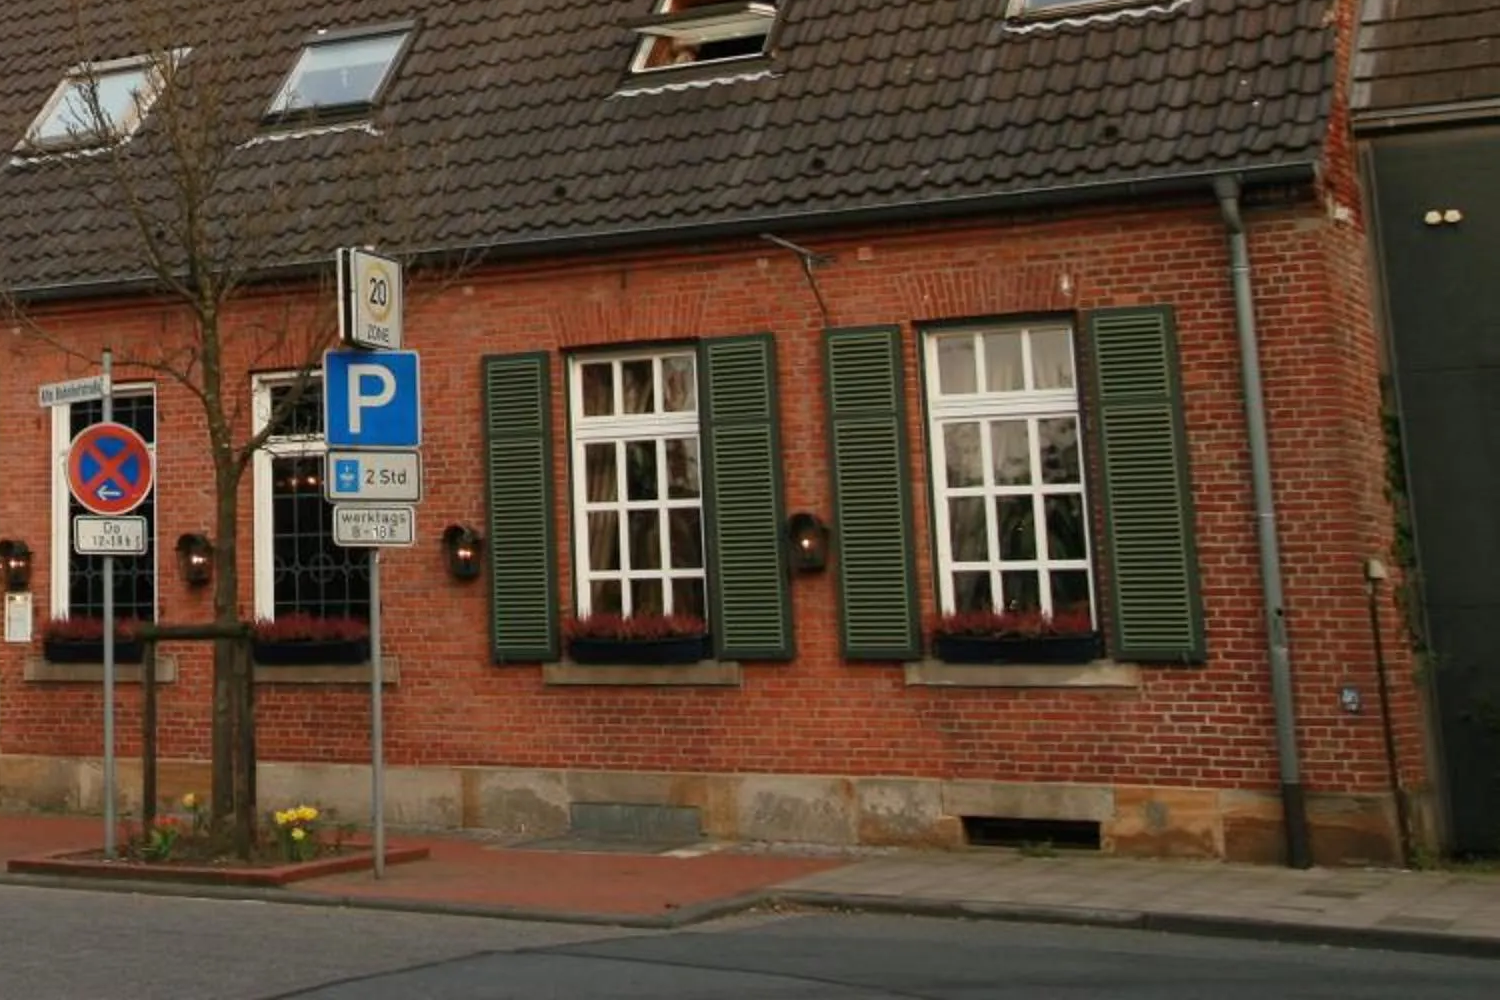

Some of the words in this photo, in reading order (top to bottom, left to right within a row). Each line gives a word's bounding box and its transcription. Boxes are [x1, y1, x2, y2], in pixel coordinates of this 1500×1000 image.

[369, 276, 387, 307] 20
[367, 324, 389, 342] ZONE
[347, 363, 397, 434] P
[365, 469, 375, 485] 2
[379, 469, 407, 485] Std
[341, 512, 406, 526] werktags
